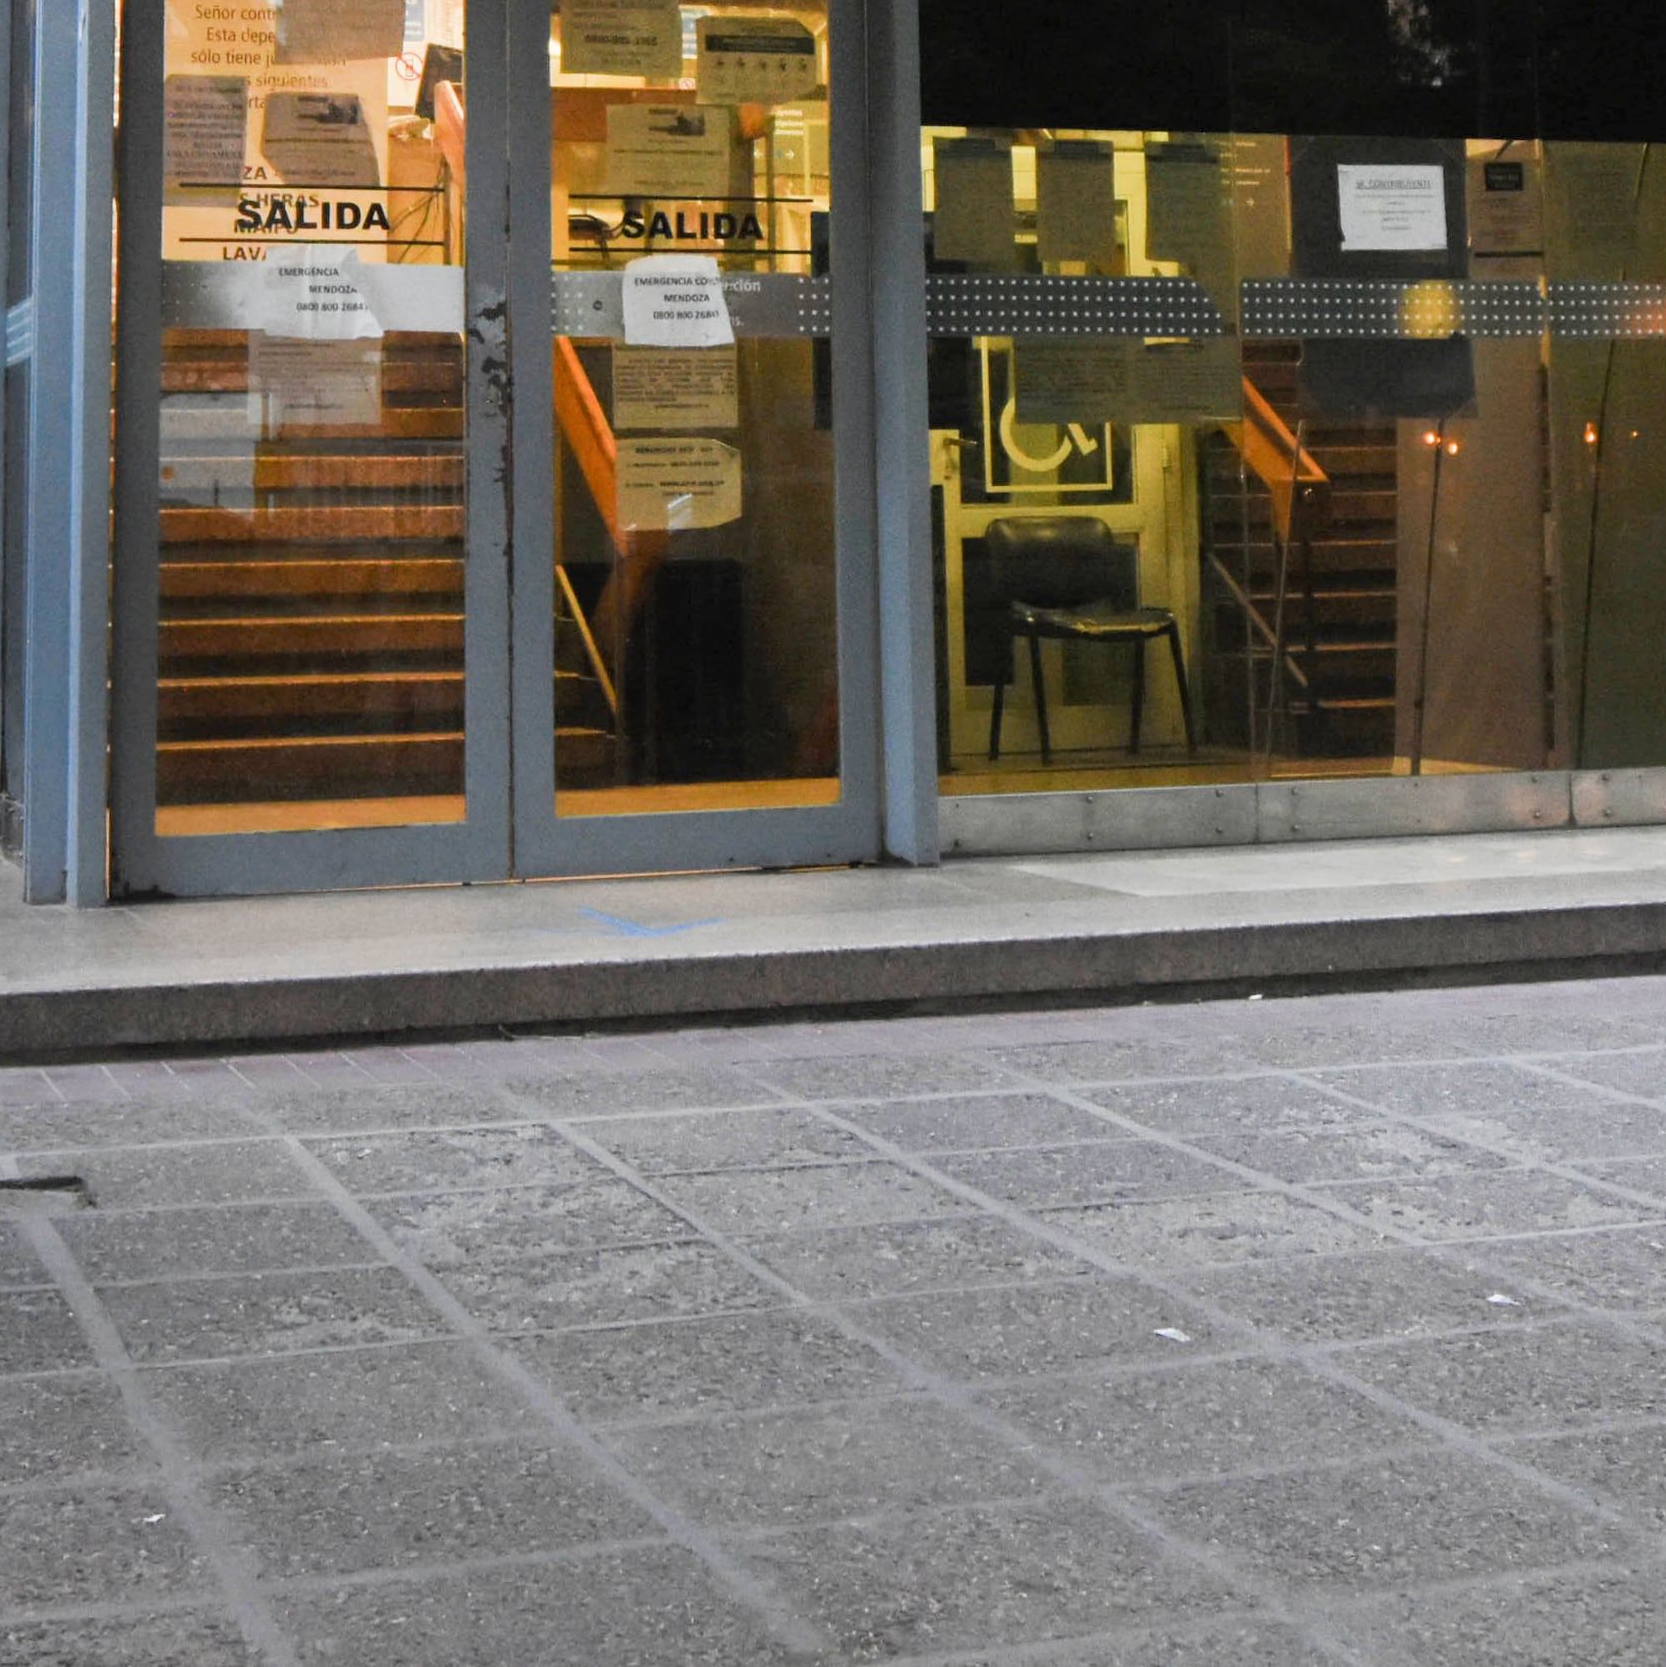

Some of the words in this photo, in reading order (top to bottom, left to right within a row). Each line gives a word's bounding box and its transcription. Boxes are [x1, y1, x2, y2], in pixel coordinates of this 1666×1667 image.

[196, 5, 235, 19] Señor
[206, 26, 236, 42] Esta
[191, 48, 221, 64] sólo
[226, 49, 261, 65] tiene
[237, 200, 390, 231] SALIDA
[622, 211, 763, 240] SALIDA
[634, 277, 693, 287] EMERGENCIA
[664, 294, 710, 303] MENDOZA
